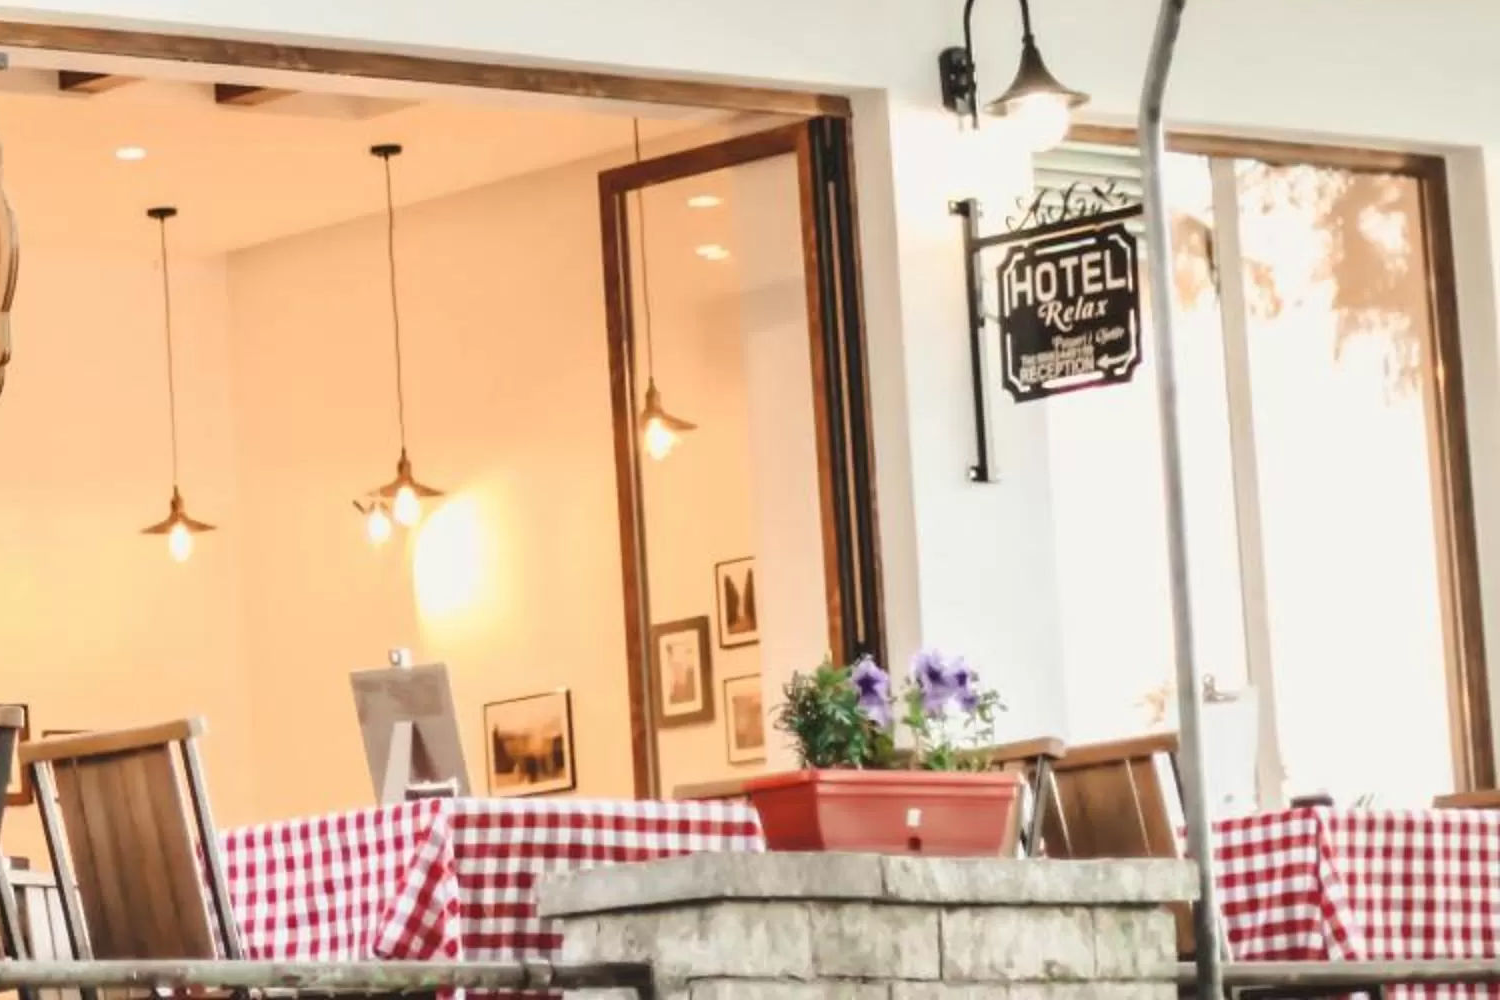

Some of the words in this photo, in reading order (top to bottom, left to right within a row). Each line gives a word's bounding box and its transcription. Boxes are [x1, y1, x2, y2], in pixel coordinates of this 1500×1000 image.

[1011, 249, 1127, 309] HOTEL
[1038, 295, 1109, 332] Relax
[1019, 355, 1095, 386] RECEPTION
